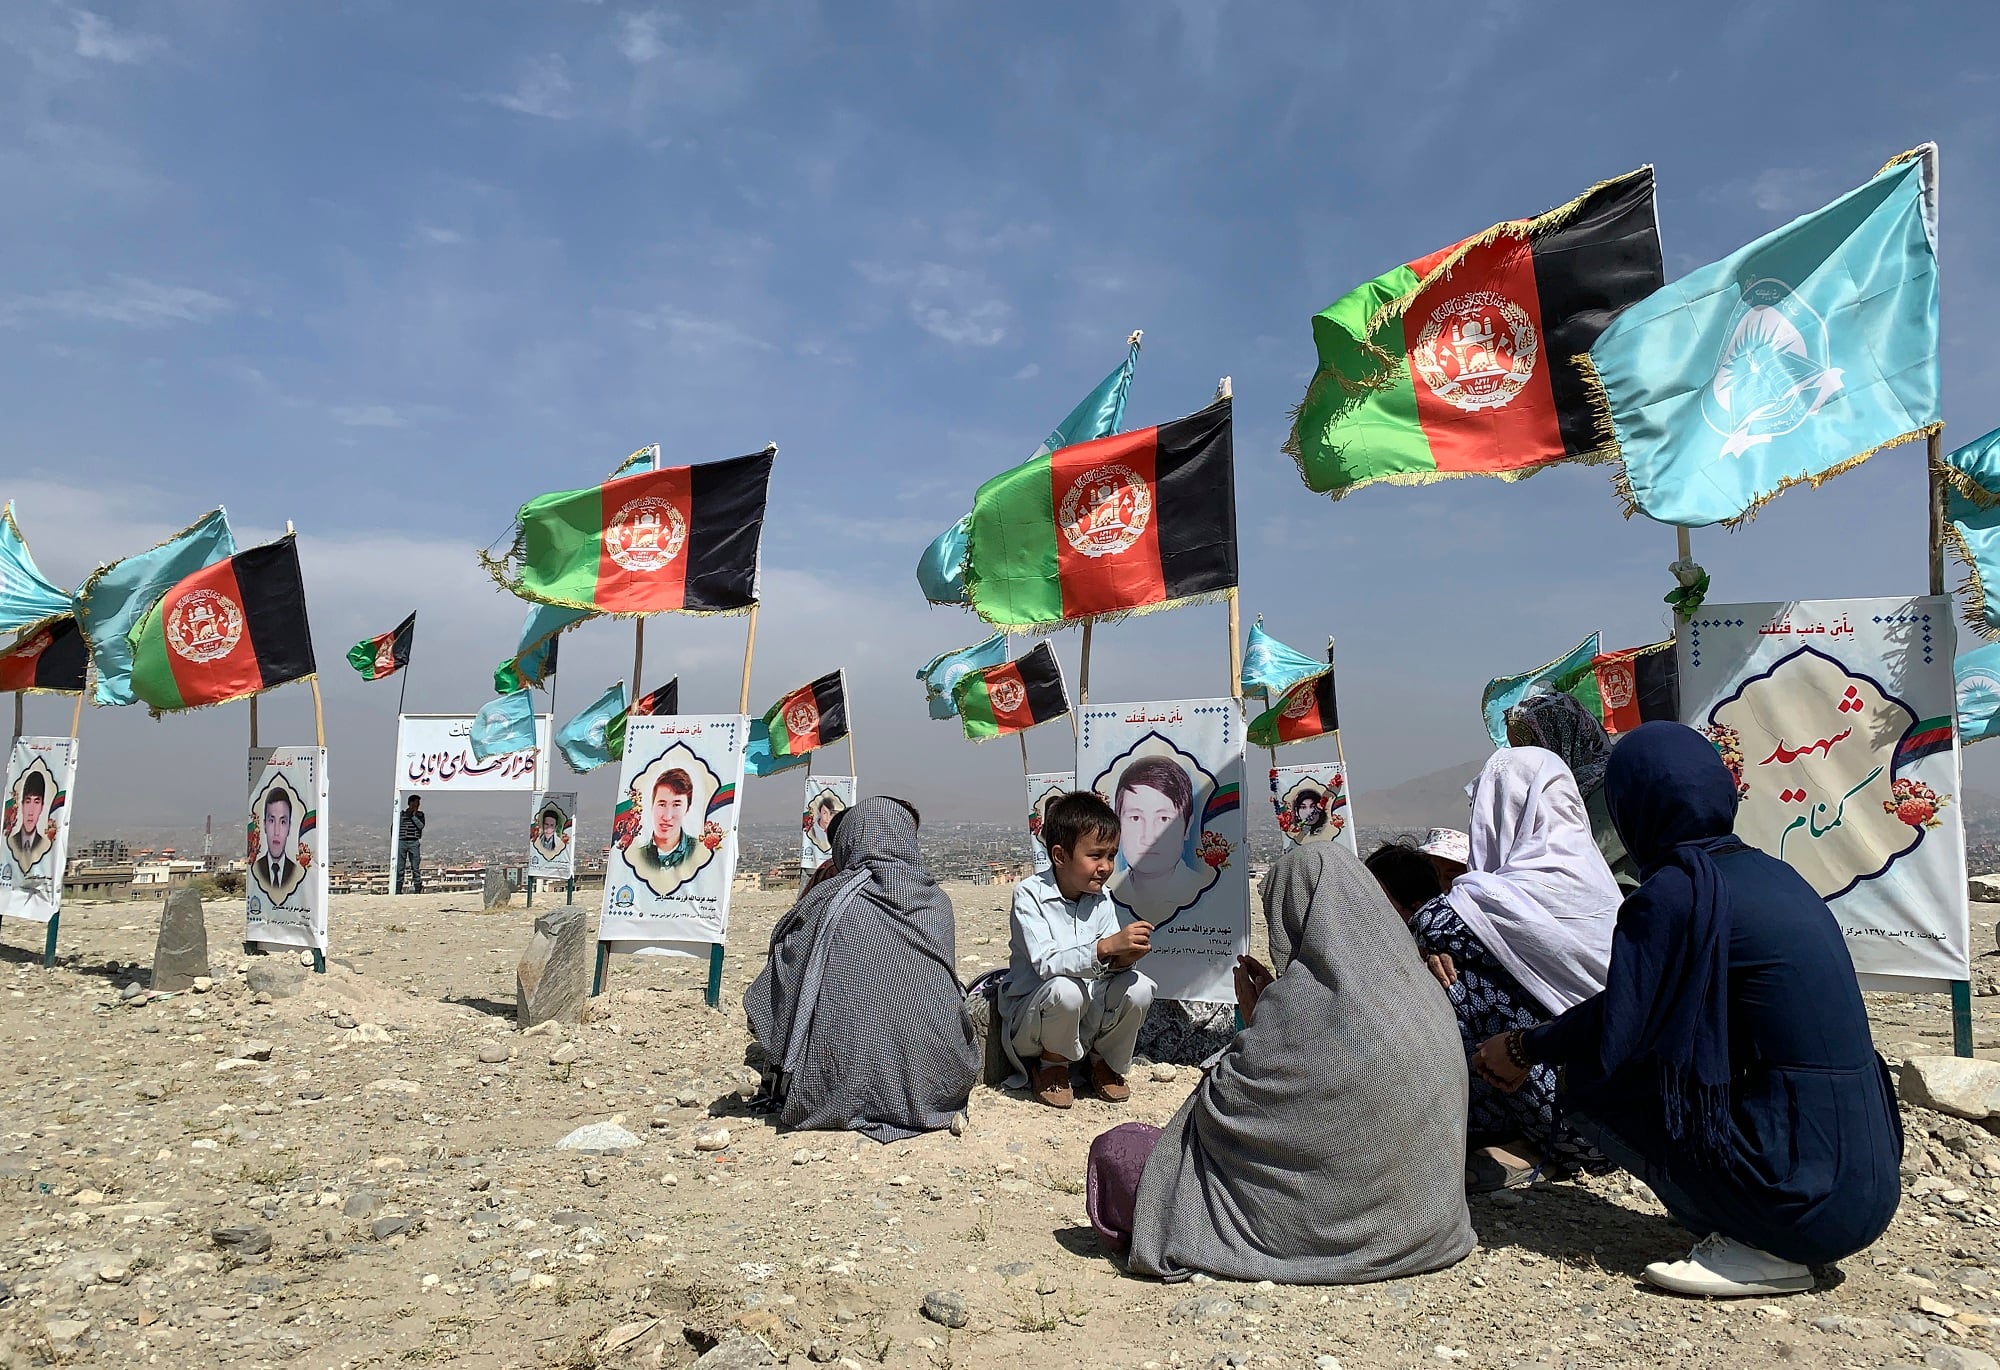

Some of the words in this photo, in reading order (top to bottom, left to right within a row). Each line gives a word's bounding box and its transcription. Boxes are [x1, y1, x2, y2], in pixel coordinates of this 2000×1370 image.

[1758, 685, 1864, 804] شهید
[1780, 766, 1884, 861] گمنام
[1217, 926, 1232, 935] شهید
[1846, 927, 1862, 937] مرکز
